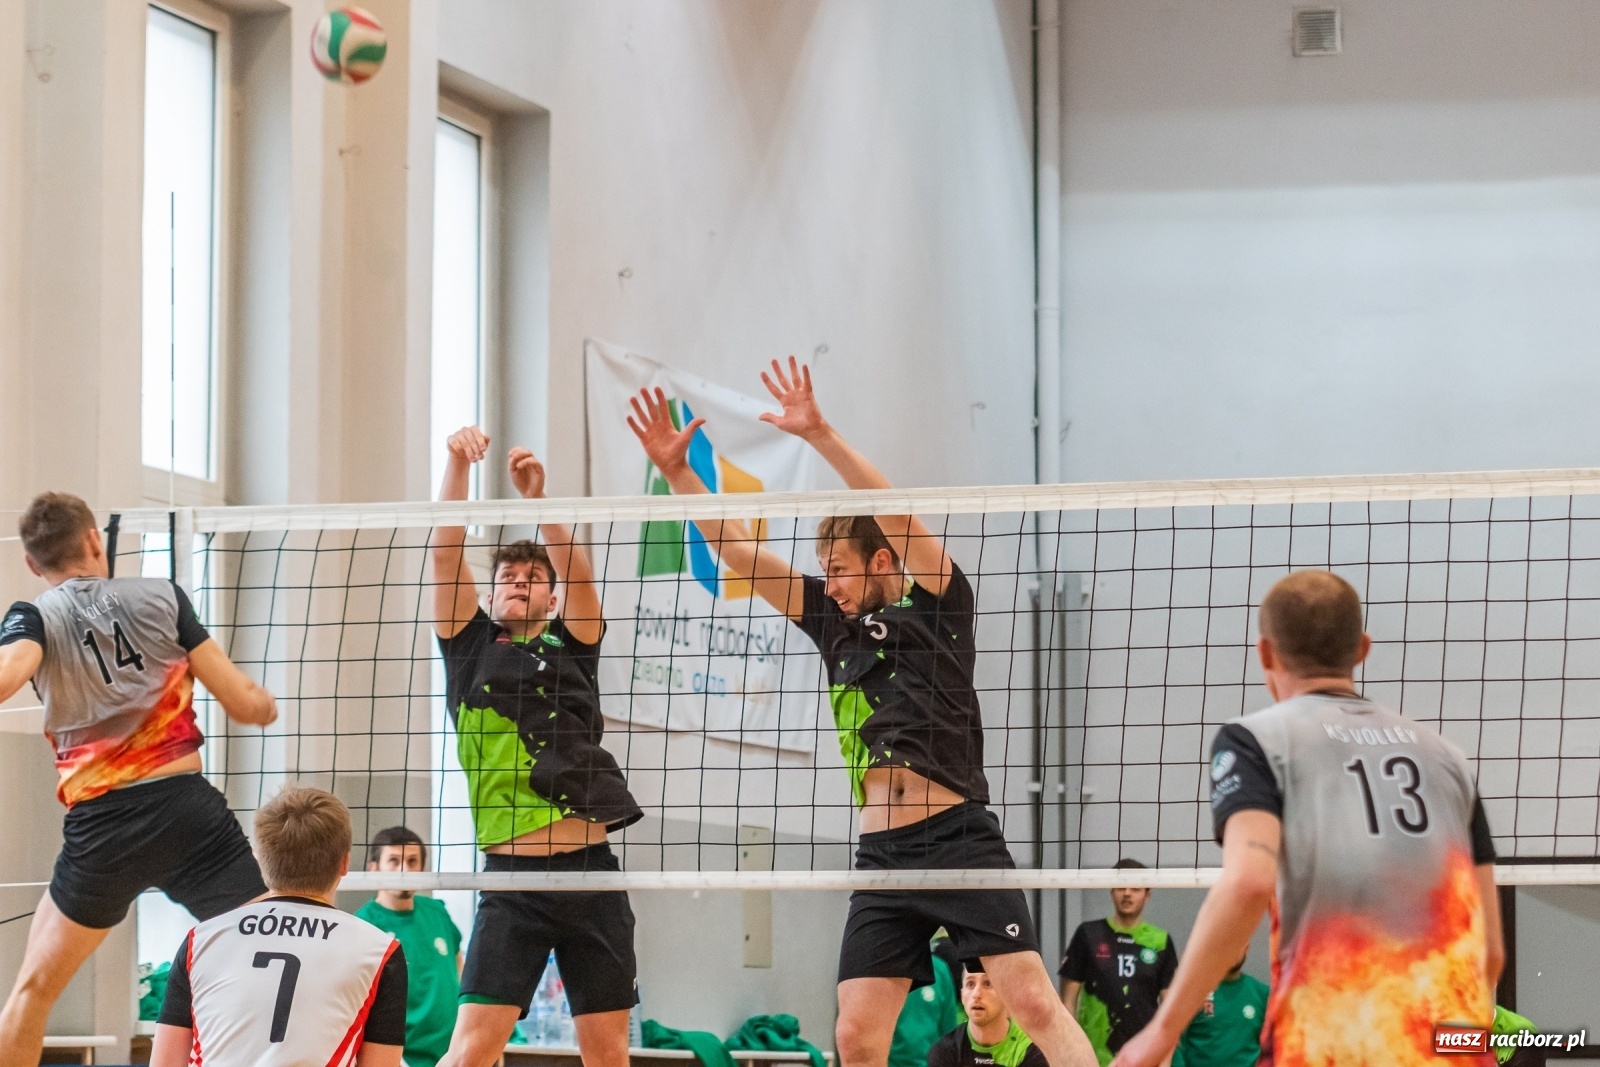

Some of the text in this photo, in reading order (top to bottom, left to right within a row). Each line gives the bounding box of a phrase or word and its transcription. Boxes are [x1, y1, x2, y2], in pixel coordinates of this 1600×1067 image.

[83, 619, 144, 685] 14
[1322, 721, 1418, 746] KS VOLLEY
[1345, 755, 1429, 837] 13
[238, 908, 338, 940] GÓRNY
[1117, 954, 1136, 977] 13
[252, 951, 302, 1043] 7
